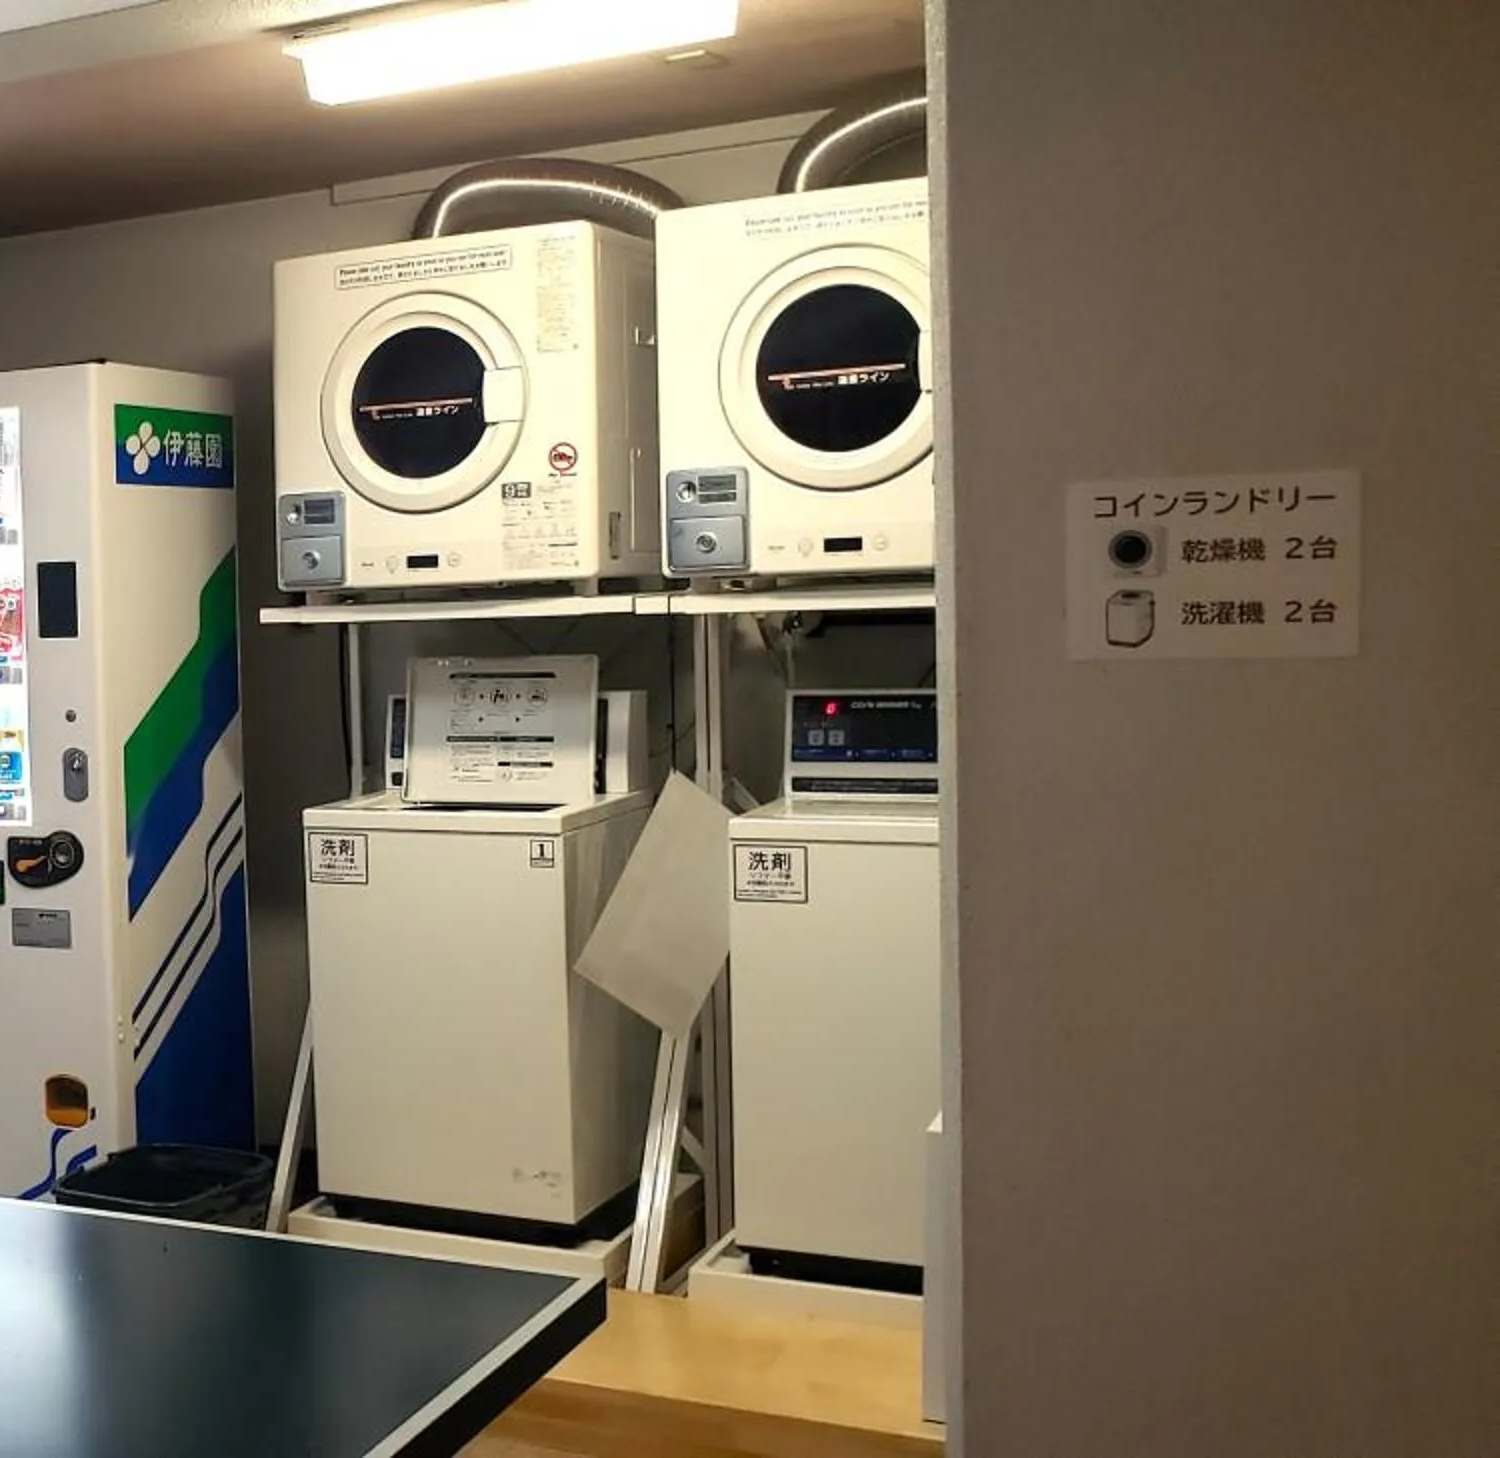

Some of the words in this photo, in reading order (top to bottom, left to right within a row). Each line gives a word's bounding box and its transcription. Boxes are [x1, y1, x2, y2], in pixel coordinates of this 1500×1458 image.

[162, 428, 223, 469] 伊藤園
[1093, 486, 1338, 518] コインランドリー
[1180, 538, 1267, 564] 乾燥機
[1284, 535, 1338, 561] 2台
[1180, 601, 1266, 625] 洗濯機
[1284, 599, 1338, 625] 2台
[321, 839, 355, 857] 洗剤
[537, 843, 545, 858] 1
[747, 851, 791, 872] 洗剤
